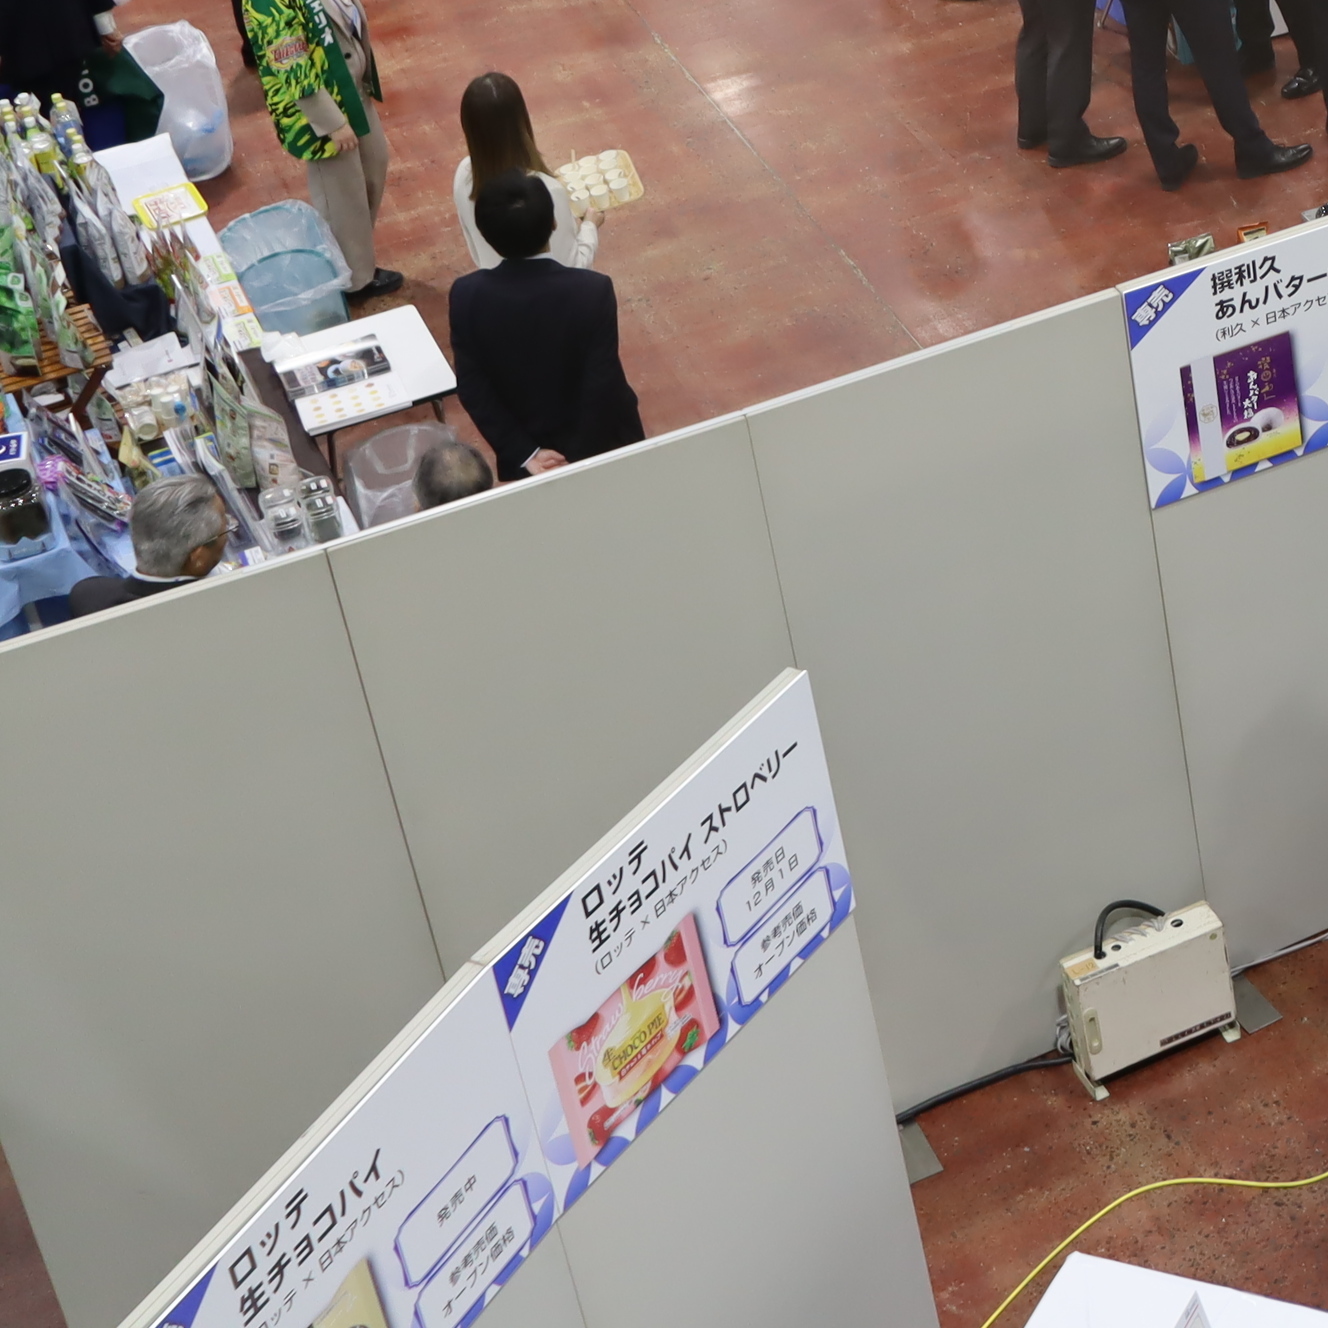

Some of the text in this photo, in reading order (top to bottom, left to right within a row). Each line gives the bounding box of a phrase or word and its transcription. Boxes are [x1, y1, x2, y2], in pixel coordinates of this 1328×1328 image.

[1131, 284, 1174, 327] 専売
[1210, 254, 1282, 296] 撰利久
[1215, 322, 1247, 343] (利久
[587, 740, 798, 954] 生チョコパイ ストロベリー
[749, 845, 786, 890] 発売日
[581, 839, 649, 920] ロッテ
[654, 839, 728, 919] 日本アクセス)
[745, 853, 800, 913] 12月1日
[753, 906, 819, 981] オープン価格
[760, 902, 805, 954] 参考売価
[503, 935, 545, 999] 専売
[632, 970, 688, 1003] berry
[603, 1046, 617, 1063] 生
[611, 1013, 666, 1071] CHOCO PIE
[318, 1169, 405, 1273] 日本アクセス)
[437, 1174, 478, 1228] 発売中
[227, 1187, 309, 1291] ロッテ
[238, 1147, 382, 1327] 生チョコパイ
[448, 1221, 499, 1288] 参考売価
[442, 1226, 515, 1319] オープン価格
